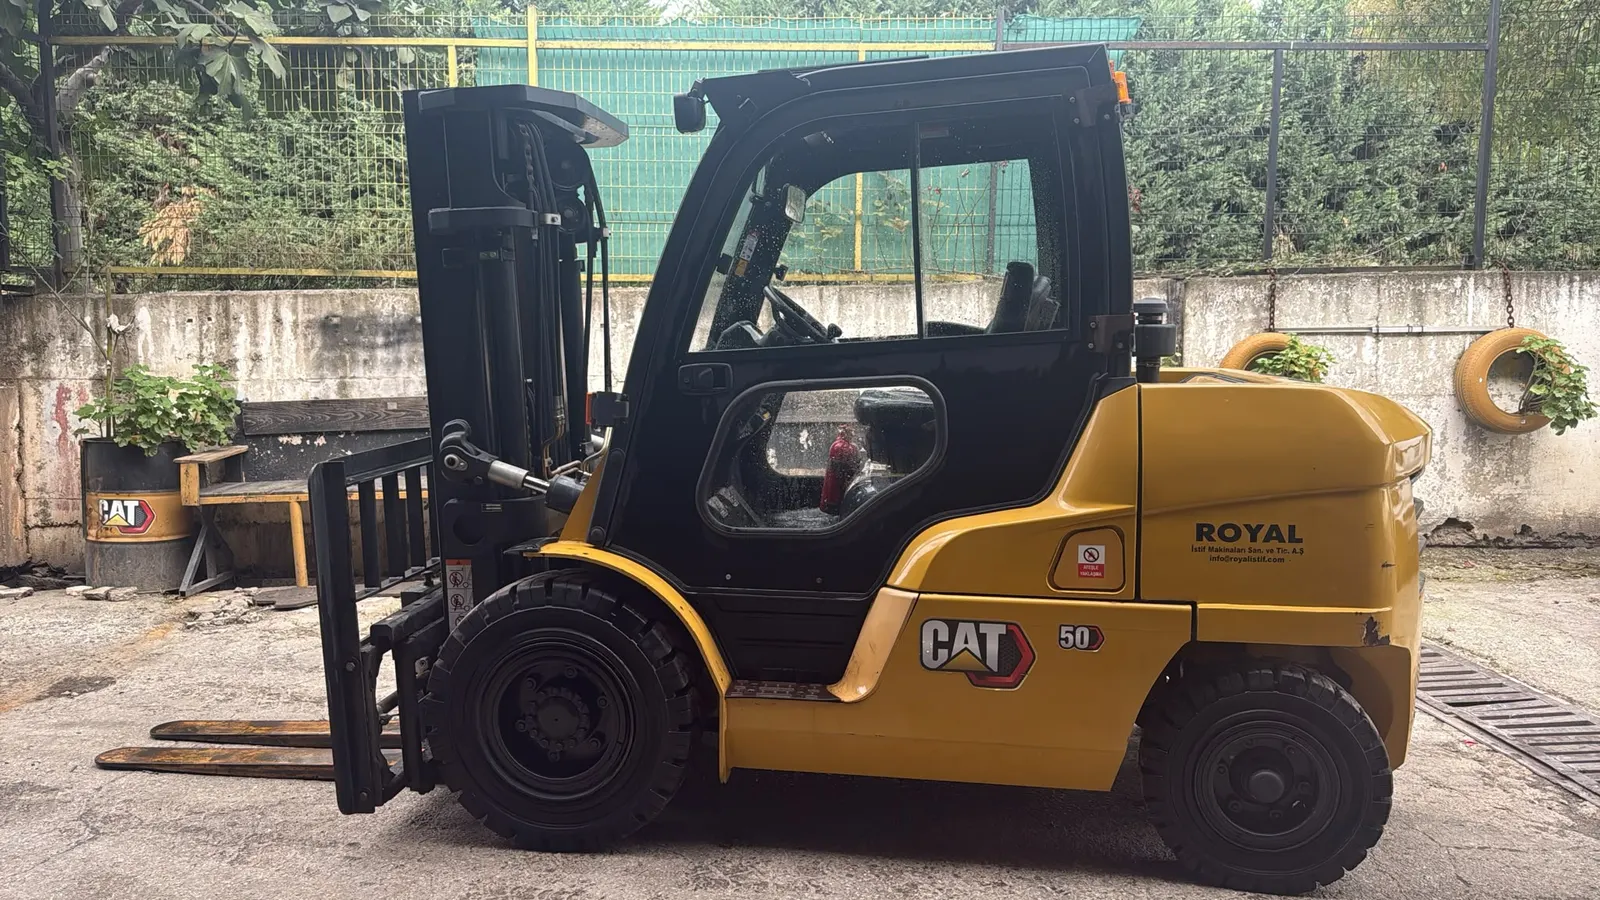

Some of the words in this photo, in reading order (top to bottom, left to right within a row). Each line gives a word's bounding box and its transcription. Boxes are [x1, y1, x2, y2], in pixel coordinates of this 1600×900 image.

[99, 499, 139, 526] CAT
[1195, 523, 1303, 543] ROYAL
[1191, 544, 1206, 553] İstif
[1208, 546, 1246, 554] Makinaları
[1247, 546, 1264, 554] San.
[1276, 547, 1290, 555] Tic.
[1209, 555, 1285, 564] info@royalistif.com
[921, 619, 1007, 673] CAT
[1060, 626, 1090, 649] 50
